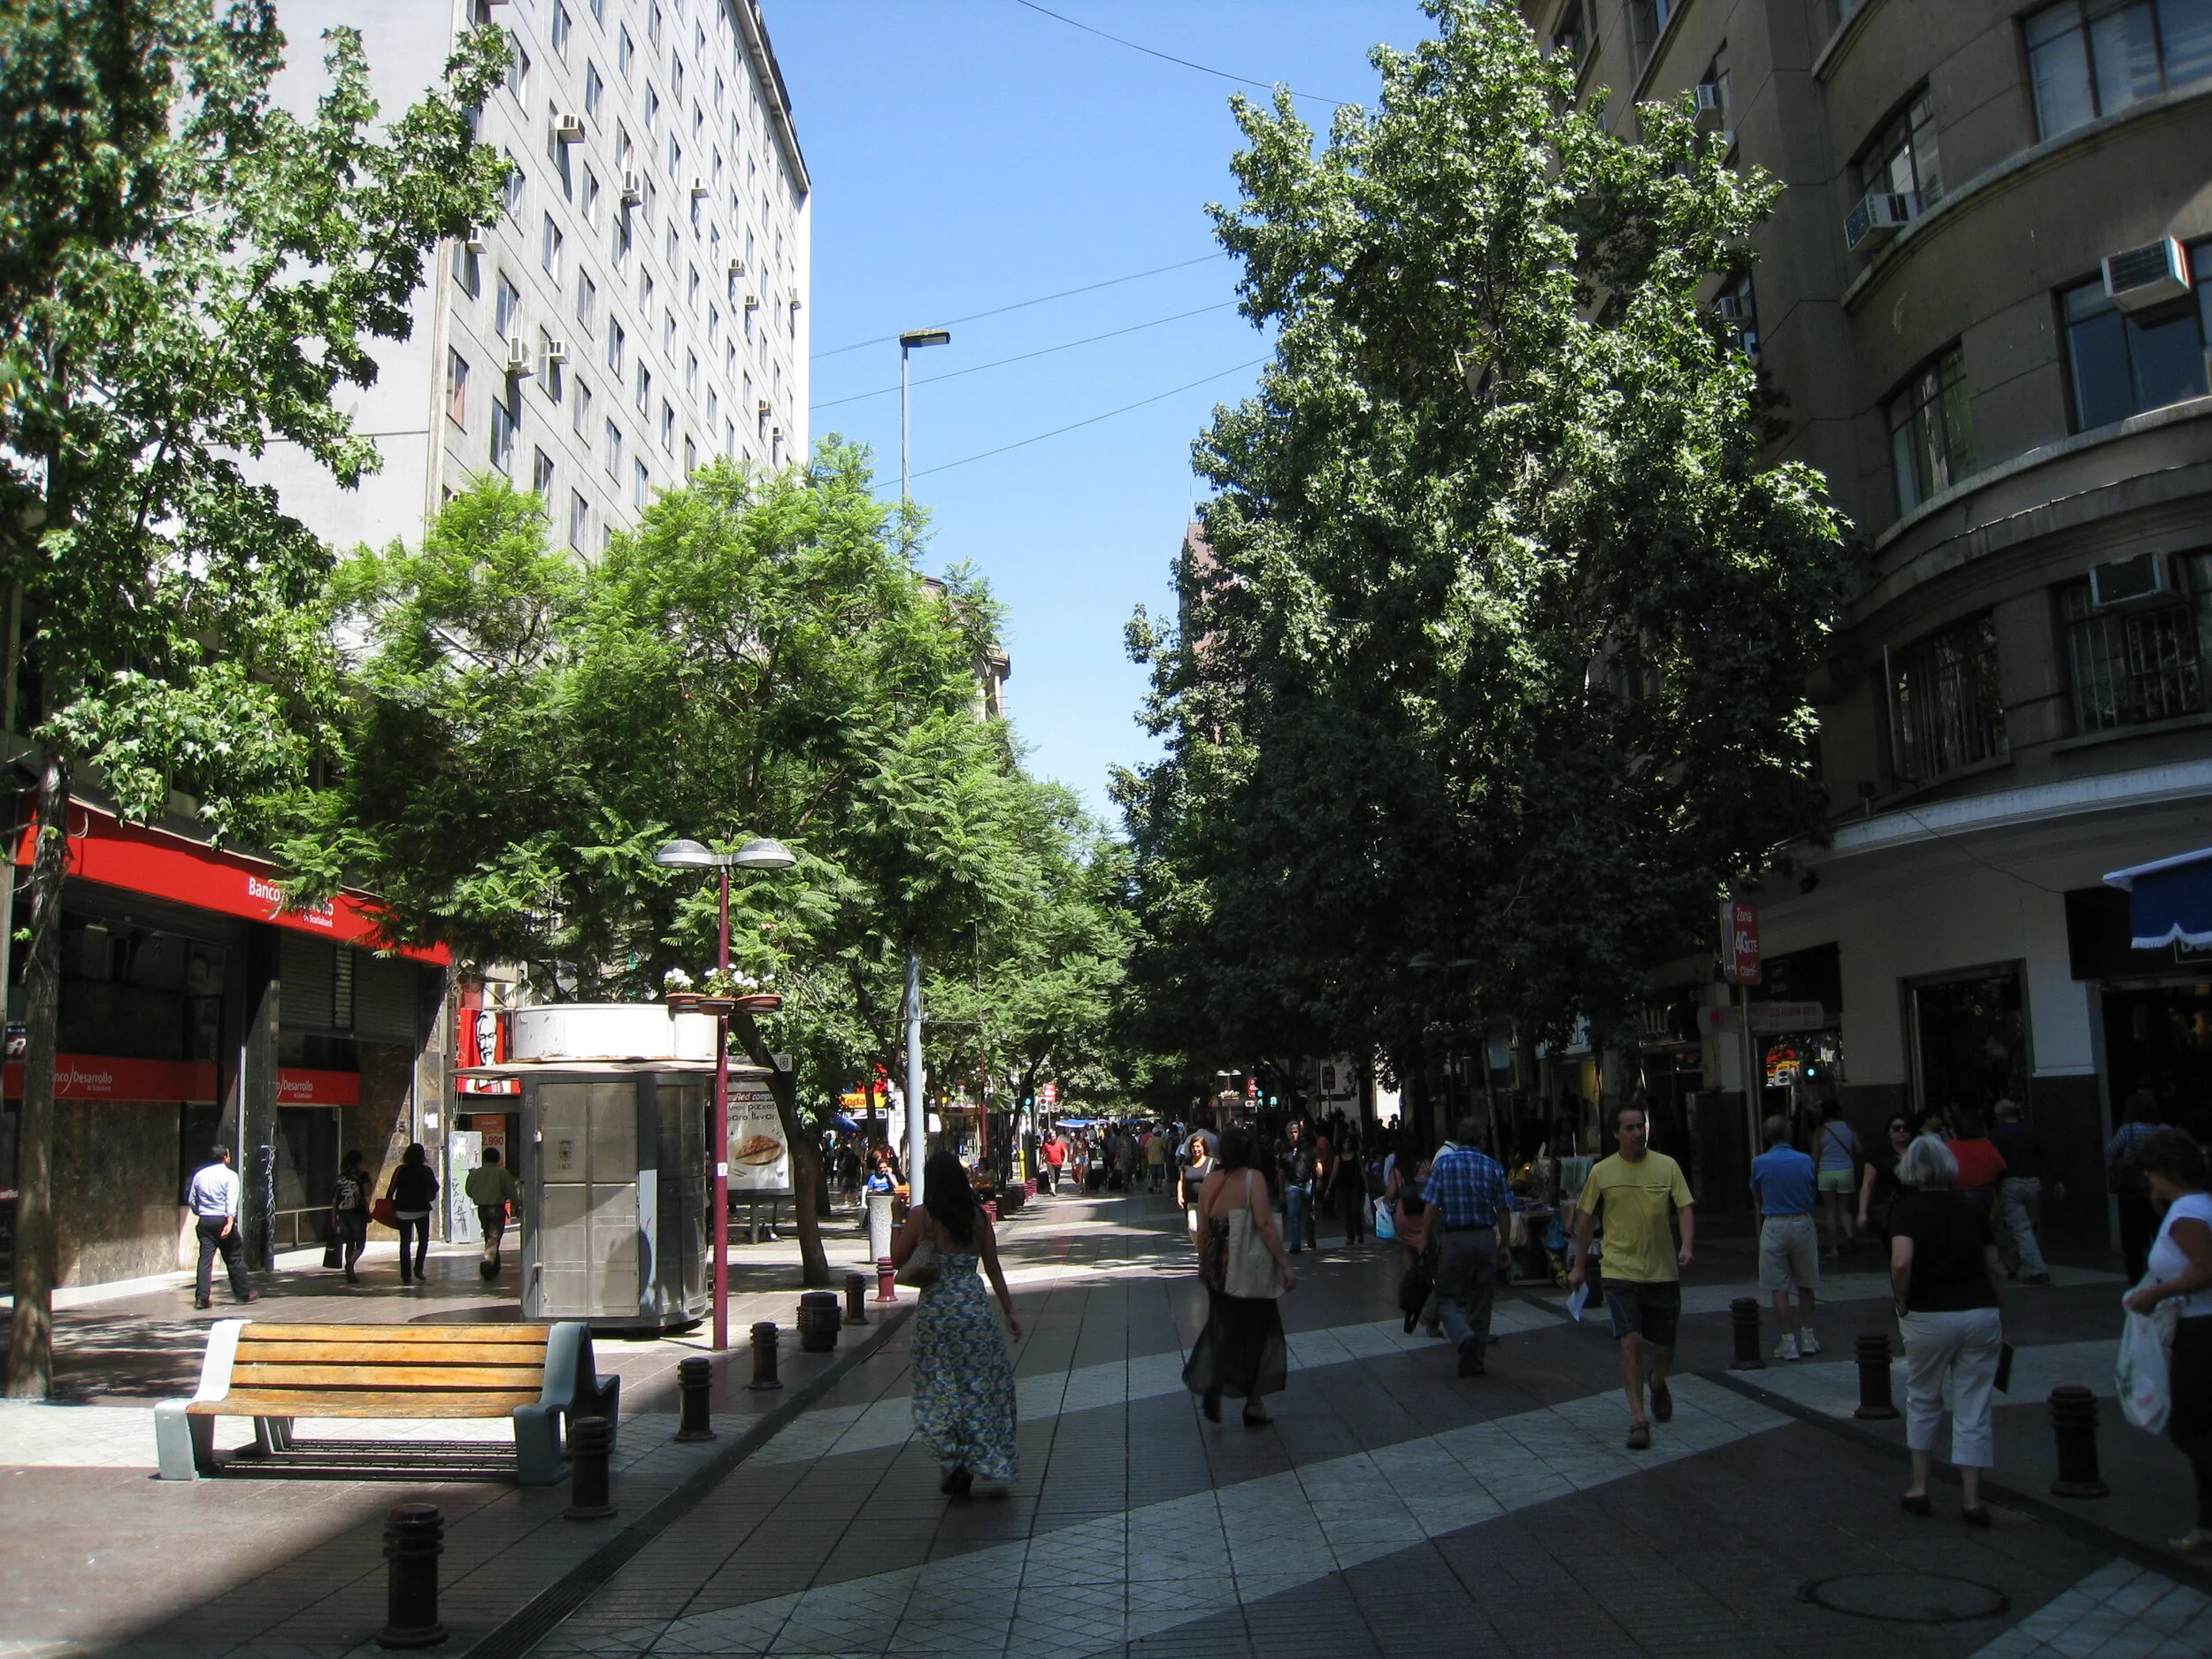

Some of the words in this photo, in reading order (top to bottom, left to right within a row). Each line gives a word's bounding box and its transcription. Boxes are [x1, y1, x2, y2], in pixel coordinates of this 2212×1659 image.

[249, 877, 280, 902] Banco
[1736, 908, 1753, 923] Zona
[73, 1071, 113, 1084] Desarrollo
[283, 1079, 313, 1092] Desarrollo
[733, 1092, 751, 1102] Red
[839, 1096, 865, 1107] Koda
